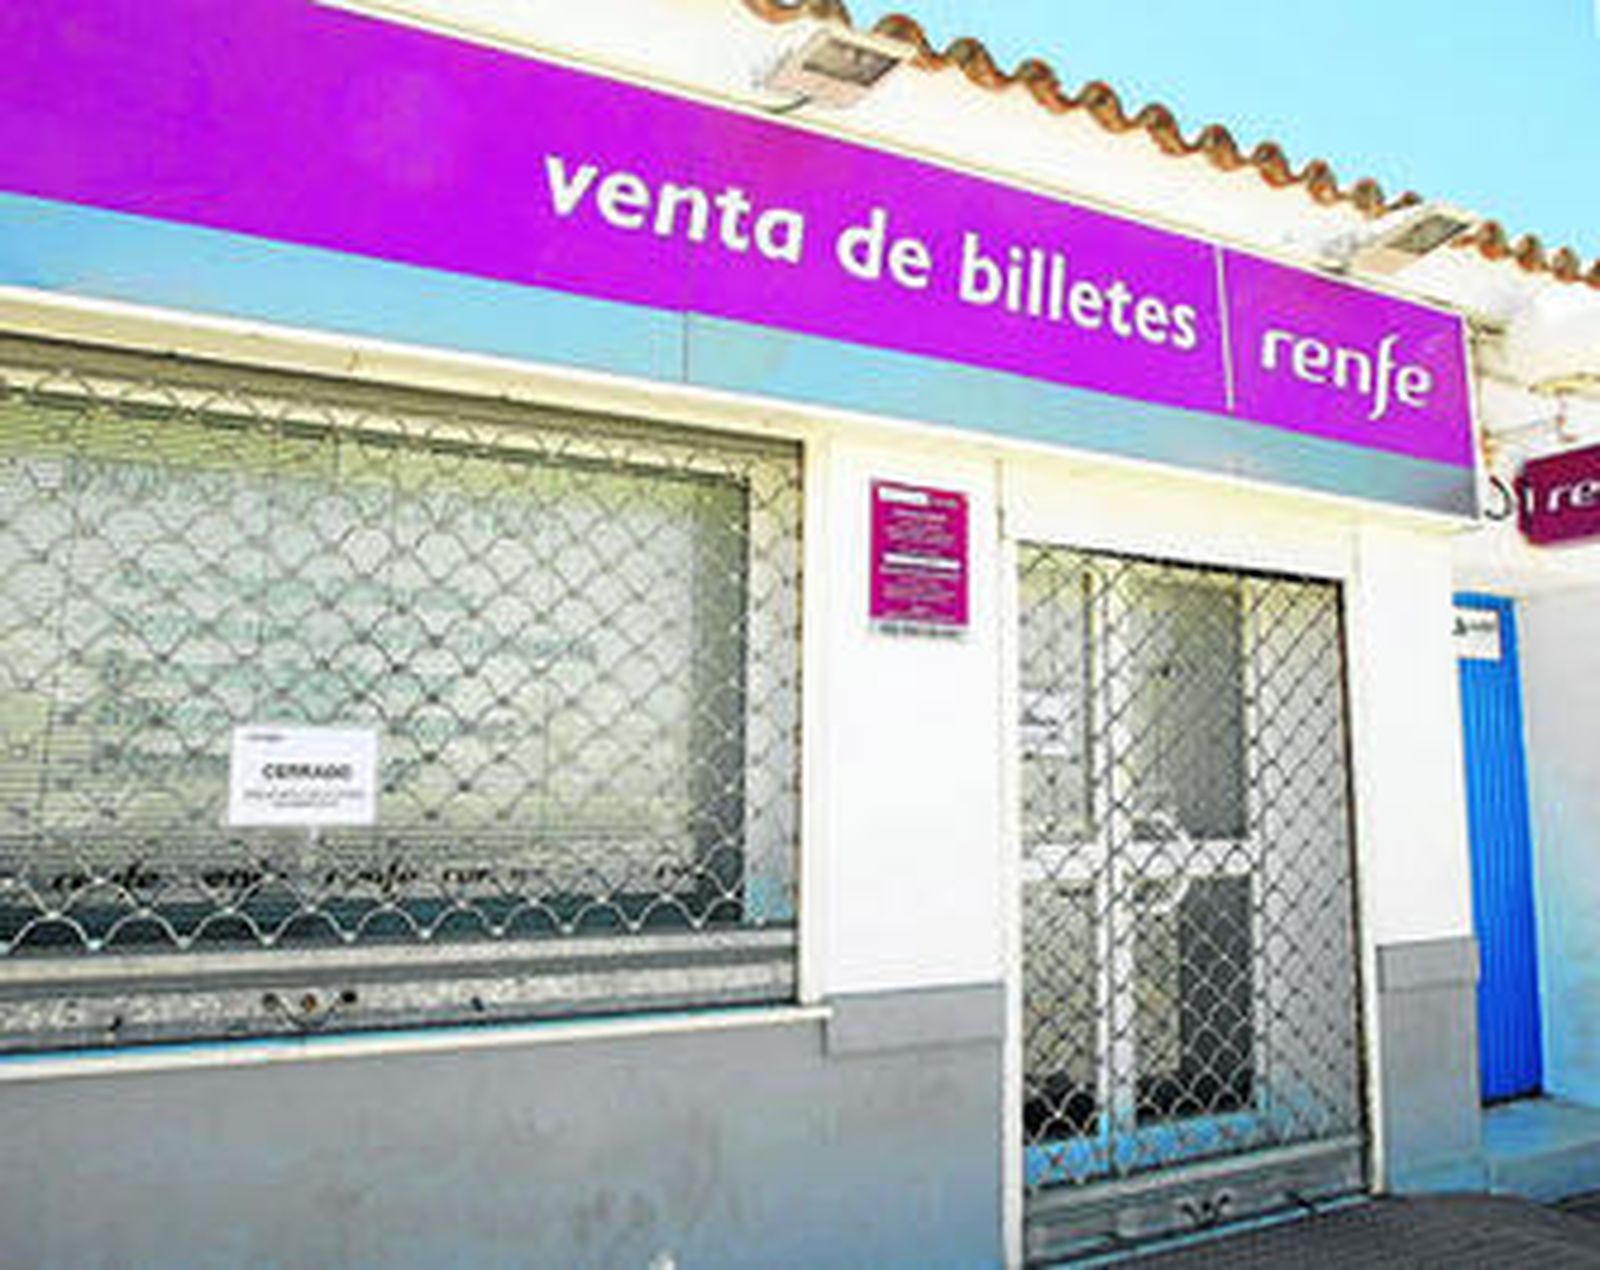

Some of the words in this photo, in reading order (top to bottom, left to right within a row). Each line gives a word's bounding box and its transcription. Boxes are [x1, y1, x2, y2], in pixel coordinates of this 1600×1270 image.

[544, 155, 806, 264] venta
[835, 207, 933, 290] de
[958, 231, 1198, 351] billetes
[1259, 328, 1434, 421] renfe
